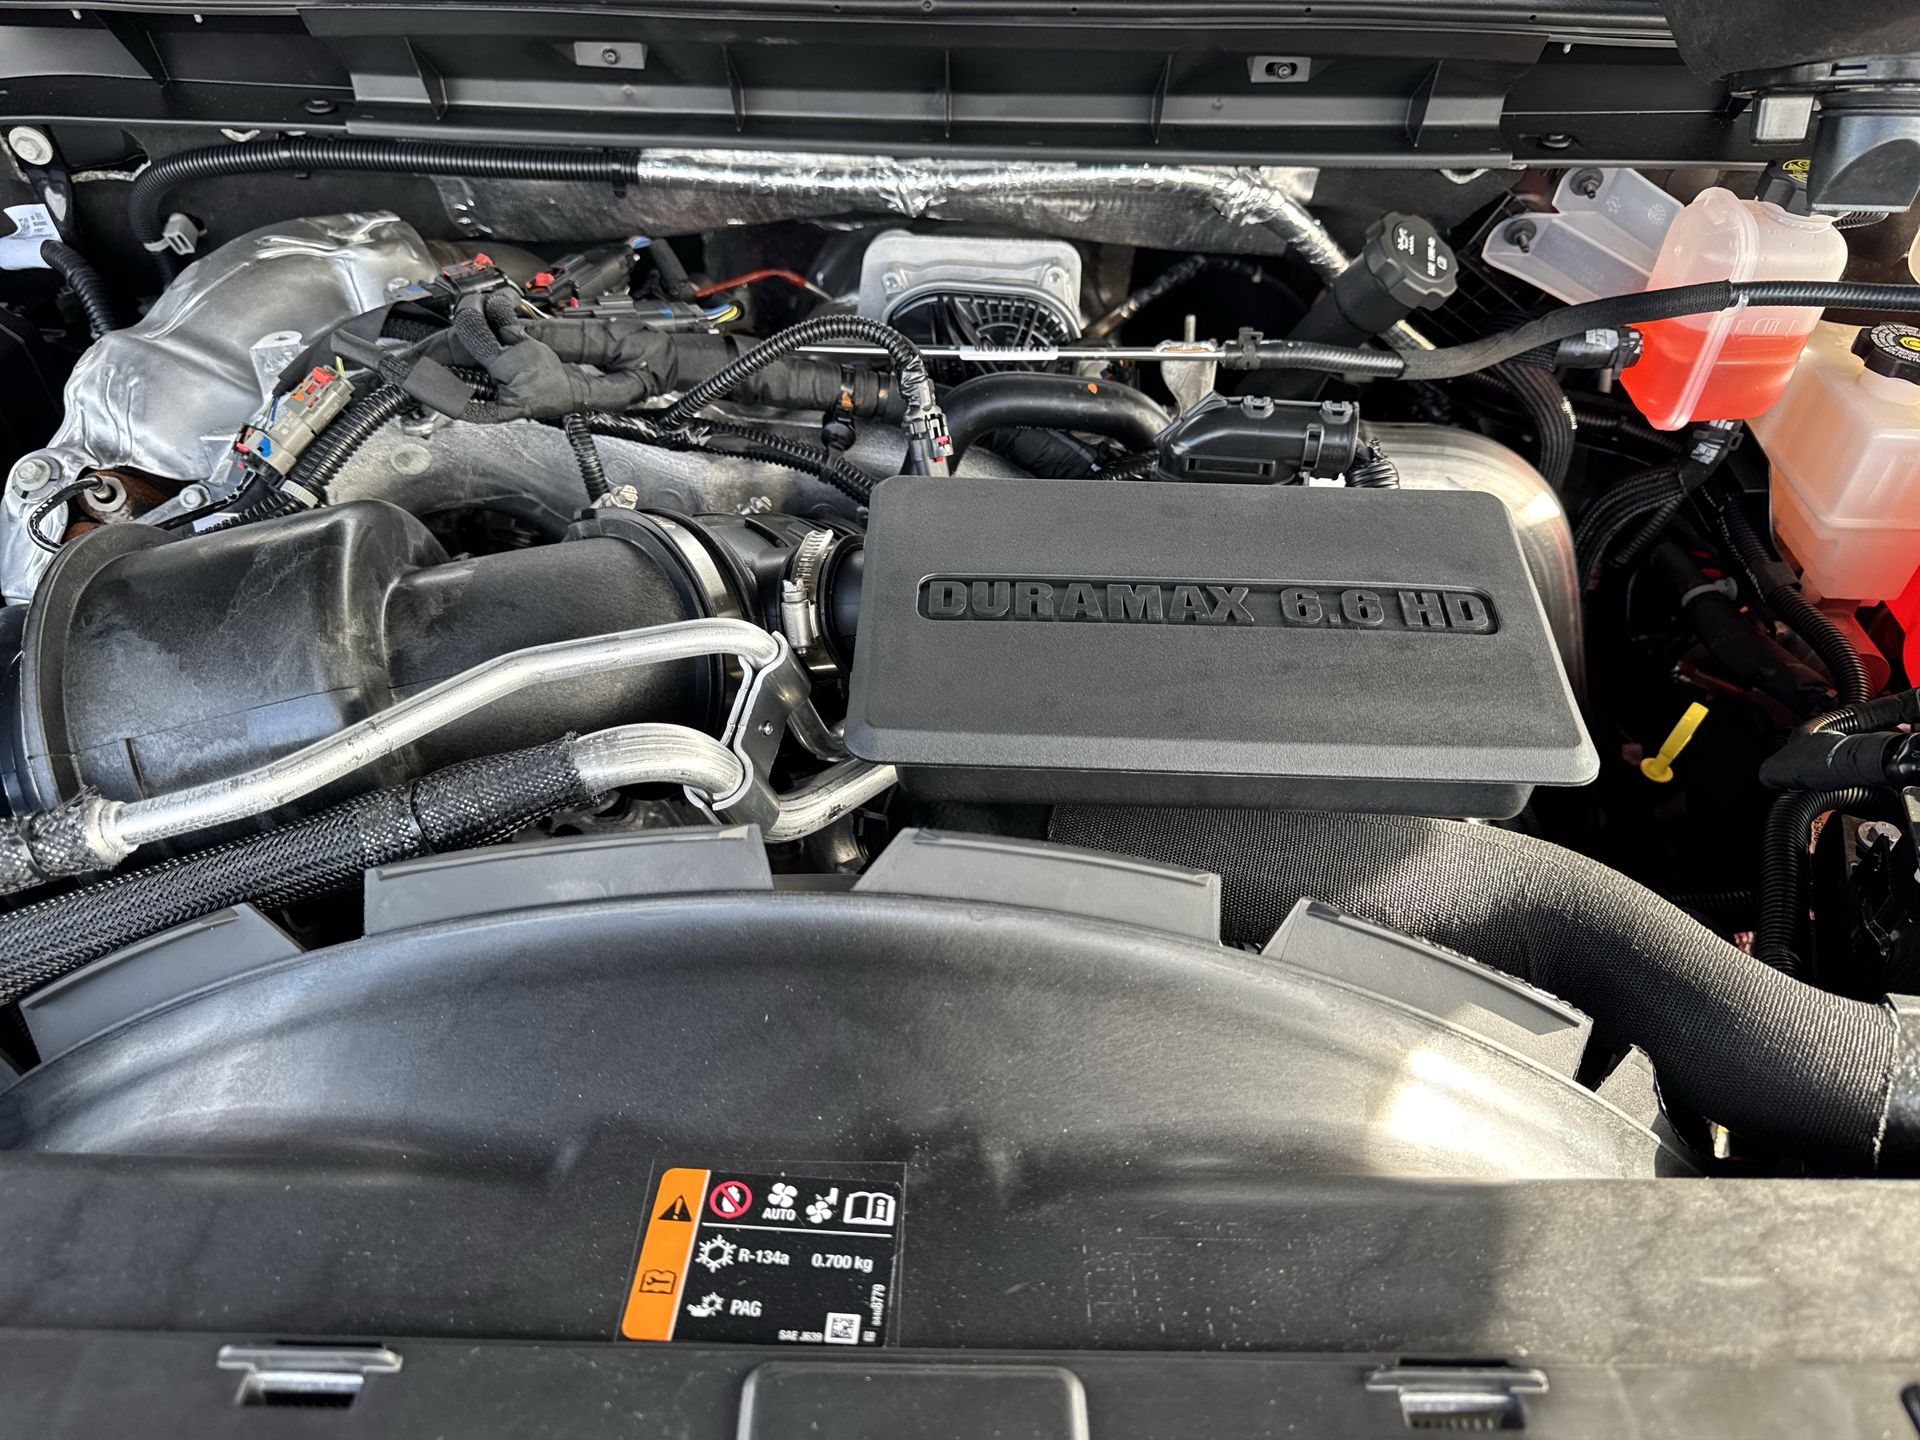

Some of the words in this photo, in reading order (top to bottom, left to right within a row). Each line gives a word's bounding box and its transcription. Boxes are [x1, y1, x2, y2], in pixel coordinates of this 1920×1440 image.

[927, 580, 1255, 623] DURAMAX
[1279, 587, 1385, 626] 6.6
[1398, 591, 1491, 631] HD
[762, 1207, 796, 1222] AUTO
[738, 1248, 790, 1266] R-134a
[811, 1252, 853, 1270] 0.700
[854, 1255, 874, 1274] kg
[729, 1299, 763, 1318] PAG
[778, 1329, 799, 1342] SAE
[799, 1330, 824, 1343] J639
